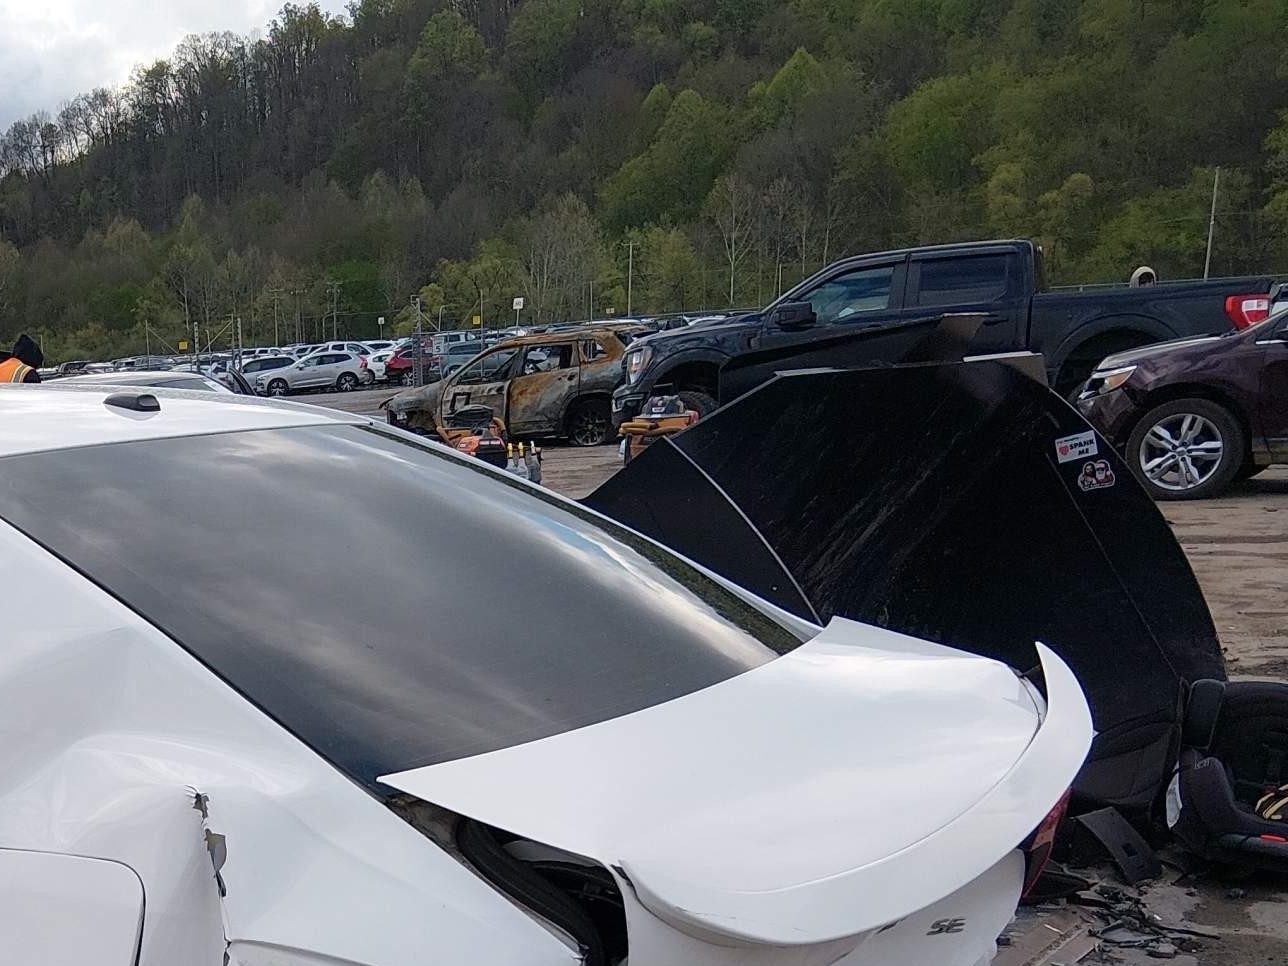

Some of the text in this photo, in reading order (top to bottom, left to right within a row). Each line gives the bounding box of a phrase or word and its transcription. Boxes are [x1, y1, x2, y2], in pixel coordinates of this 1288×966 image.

[1069, 438, 1094, 450] SPANK
[1078, 447, 1089, 456] ME
[926, 918, 966, 936] SE
